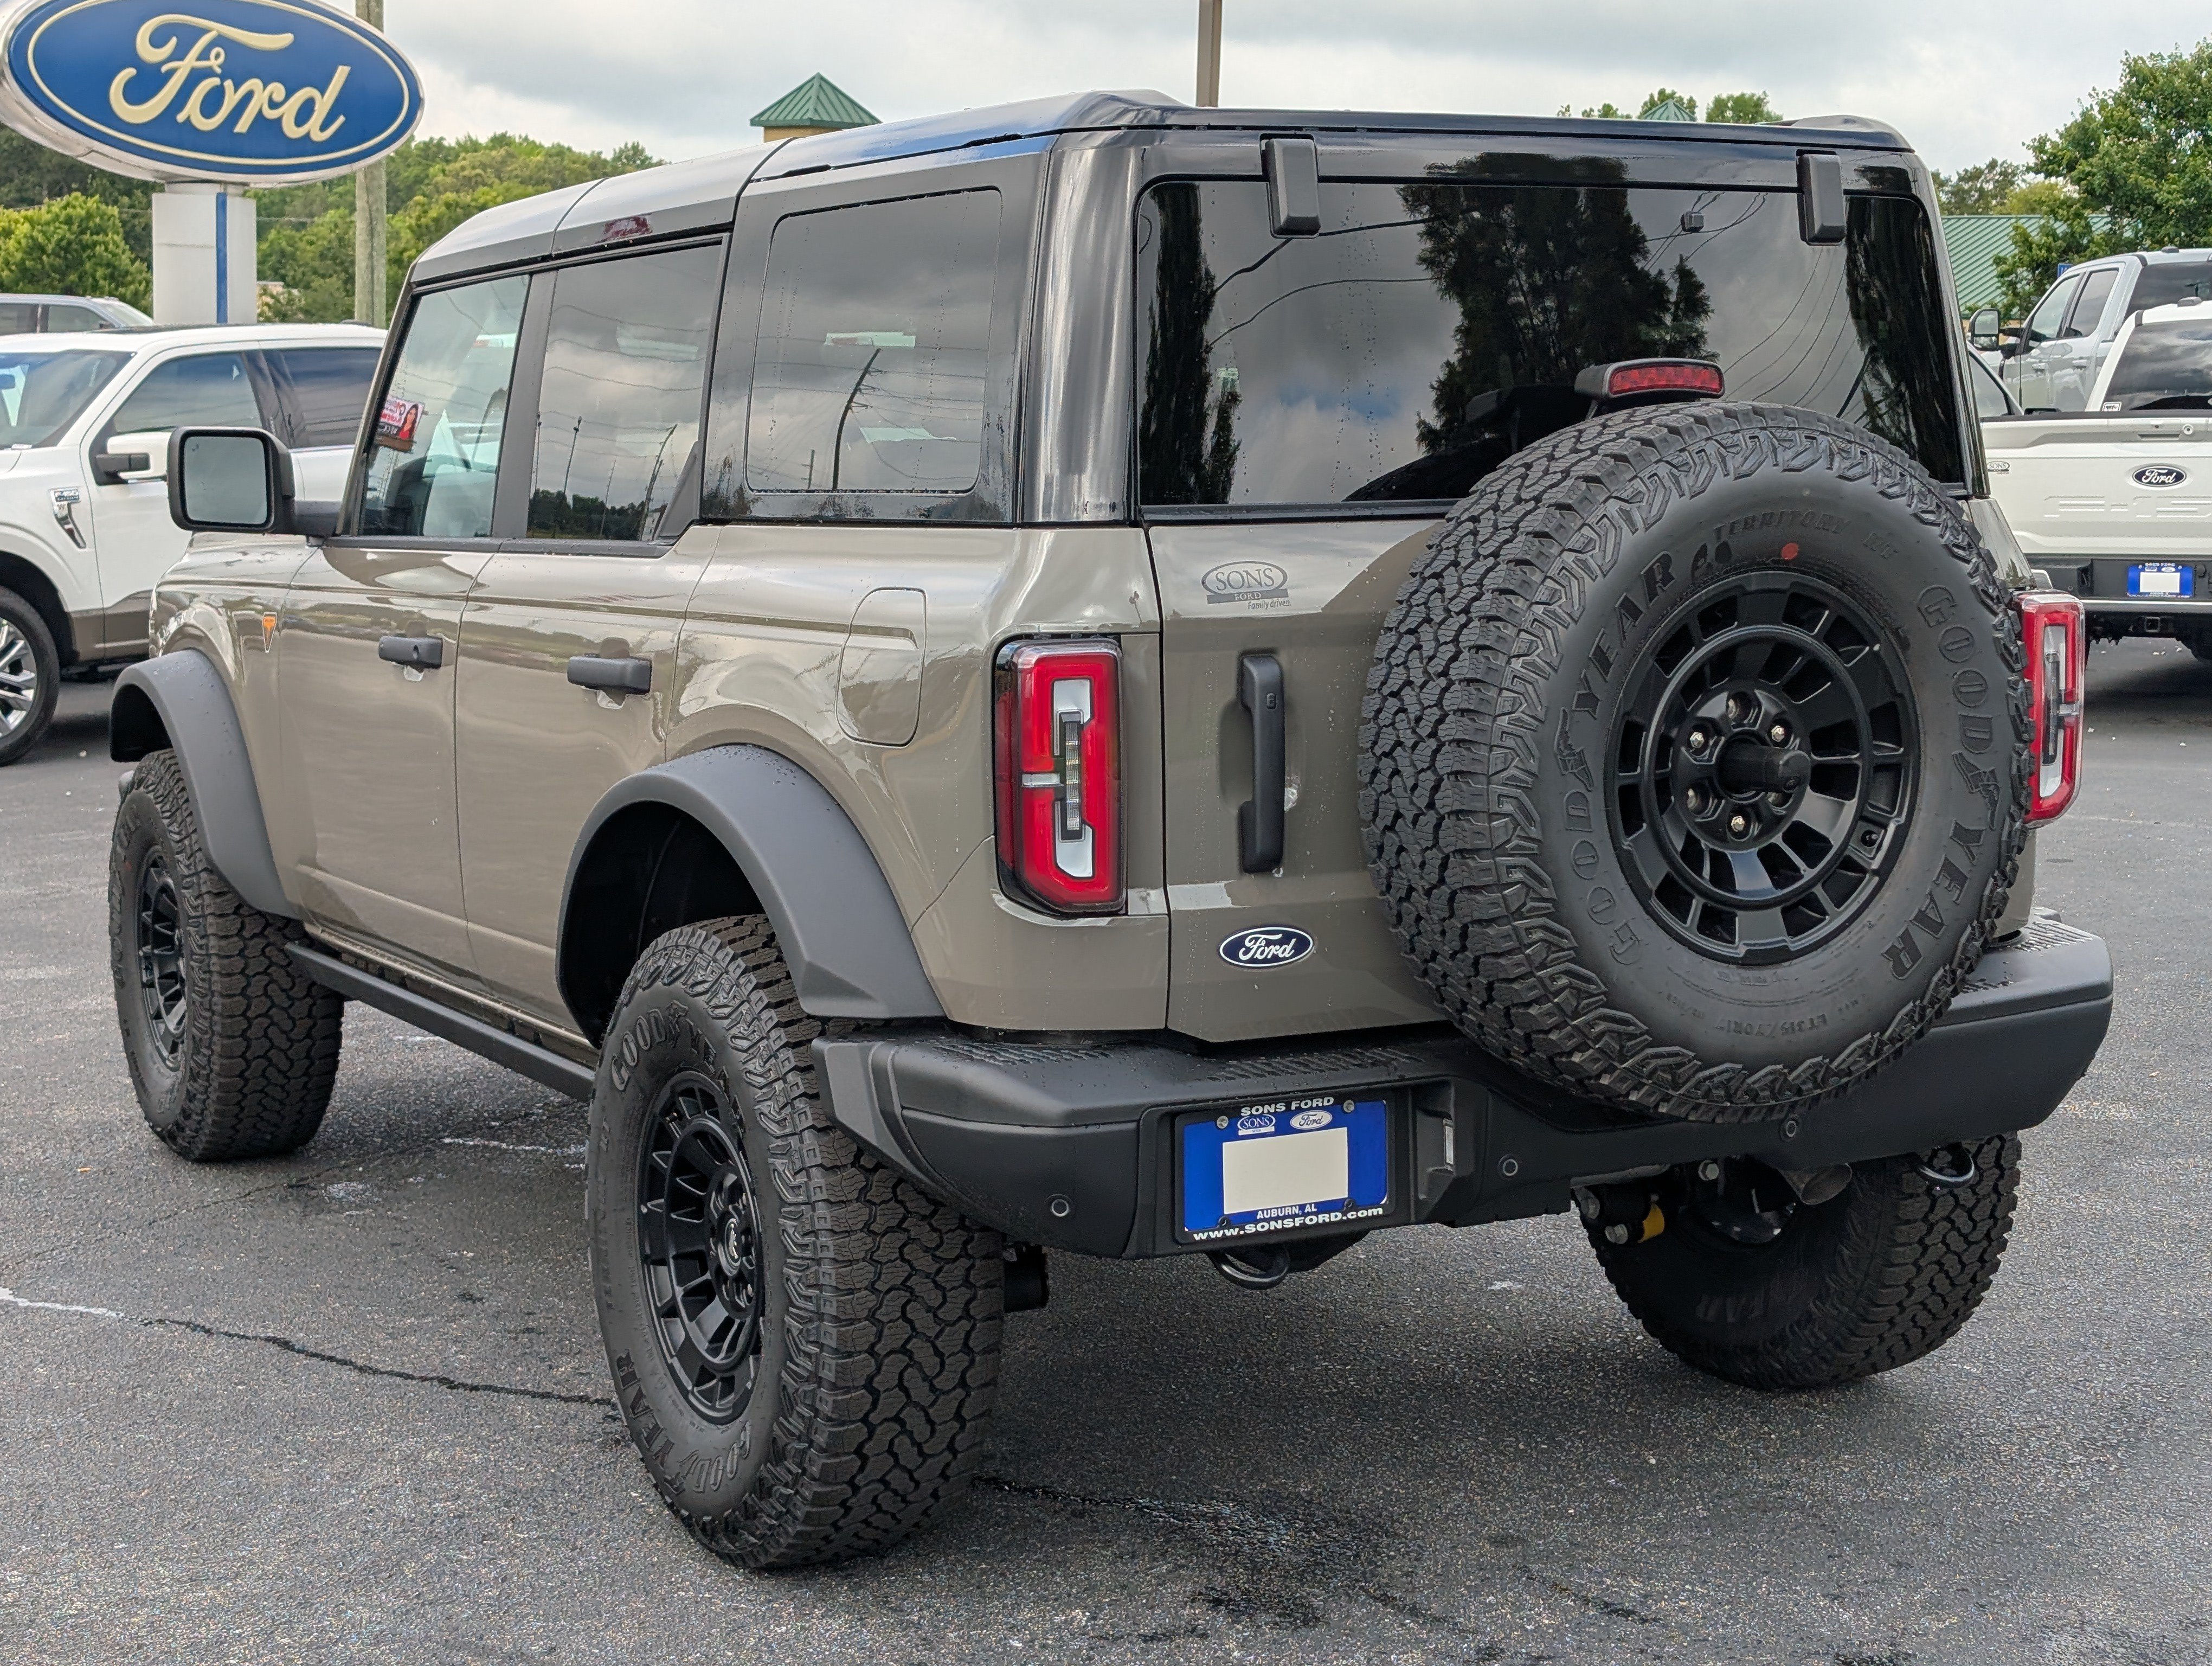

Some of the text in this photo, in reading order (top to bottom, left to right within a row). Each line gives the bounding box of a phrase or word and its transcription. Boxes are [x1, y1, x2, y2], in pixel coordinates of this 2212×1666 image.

[110, 14, 351, 142] Ford
[2142, 469, 2176, 483] Ford
[1215, 567, 1275, 591] SONS
[1234, 592, 1262, 600] FORD
[1248, 600, 1270, 610] family
[1238, 934, 1296, 960] Ford
[1240, 1097, 1335, 1116] SONS FORD
[1243, 1116, 1270, 1129] SONS
[1299, 1113, 1324, 1126] Ford
[1257, 1203, 1317, 1220] AUBURN, AL
[1193, 1207, 1383, 1240] www.SONSFORD.com
